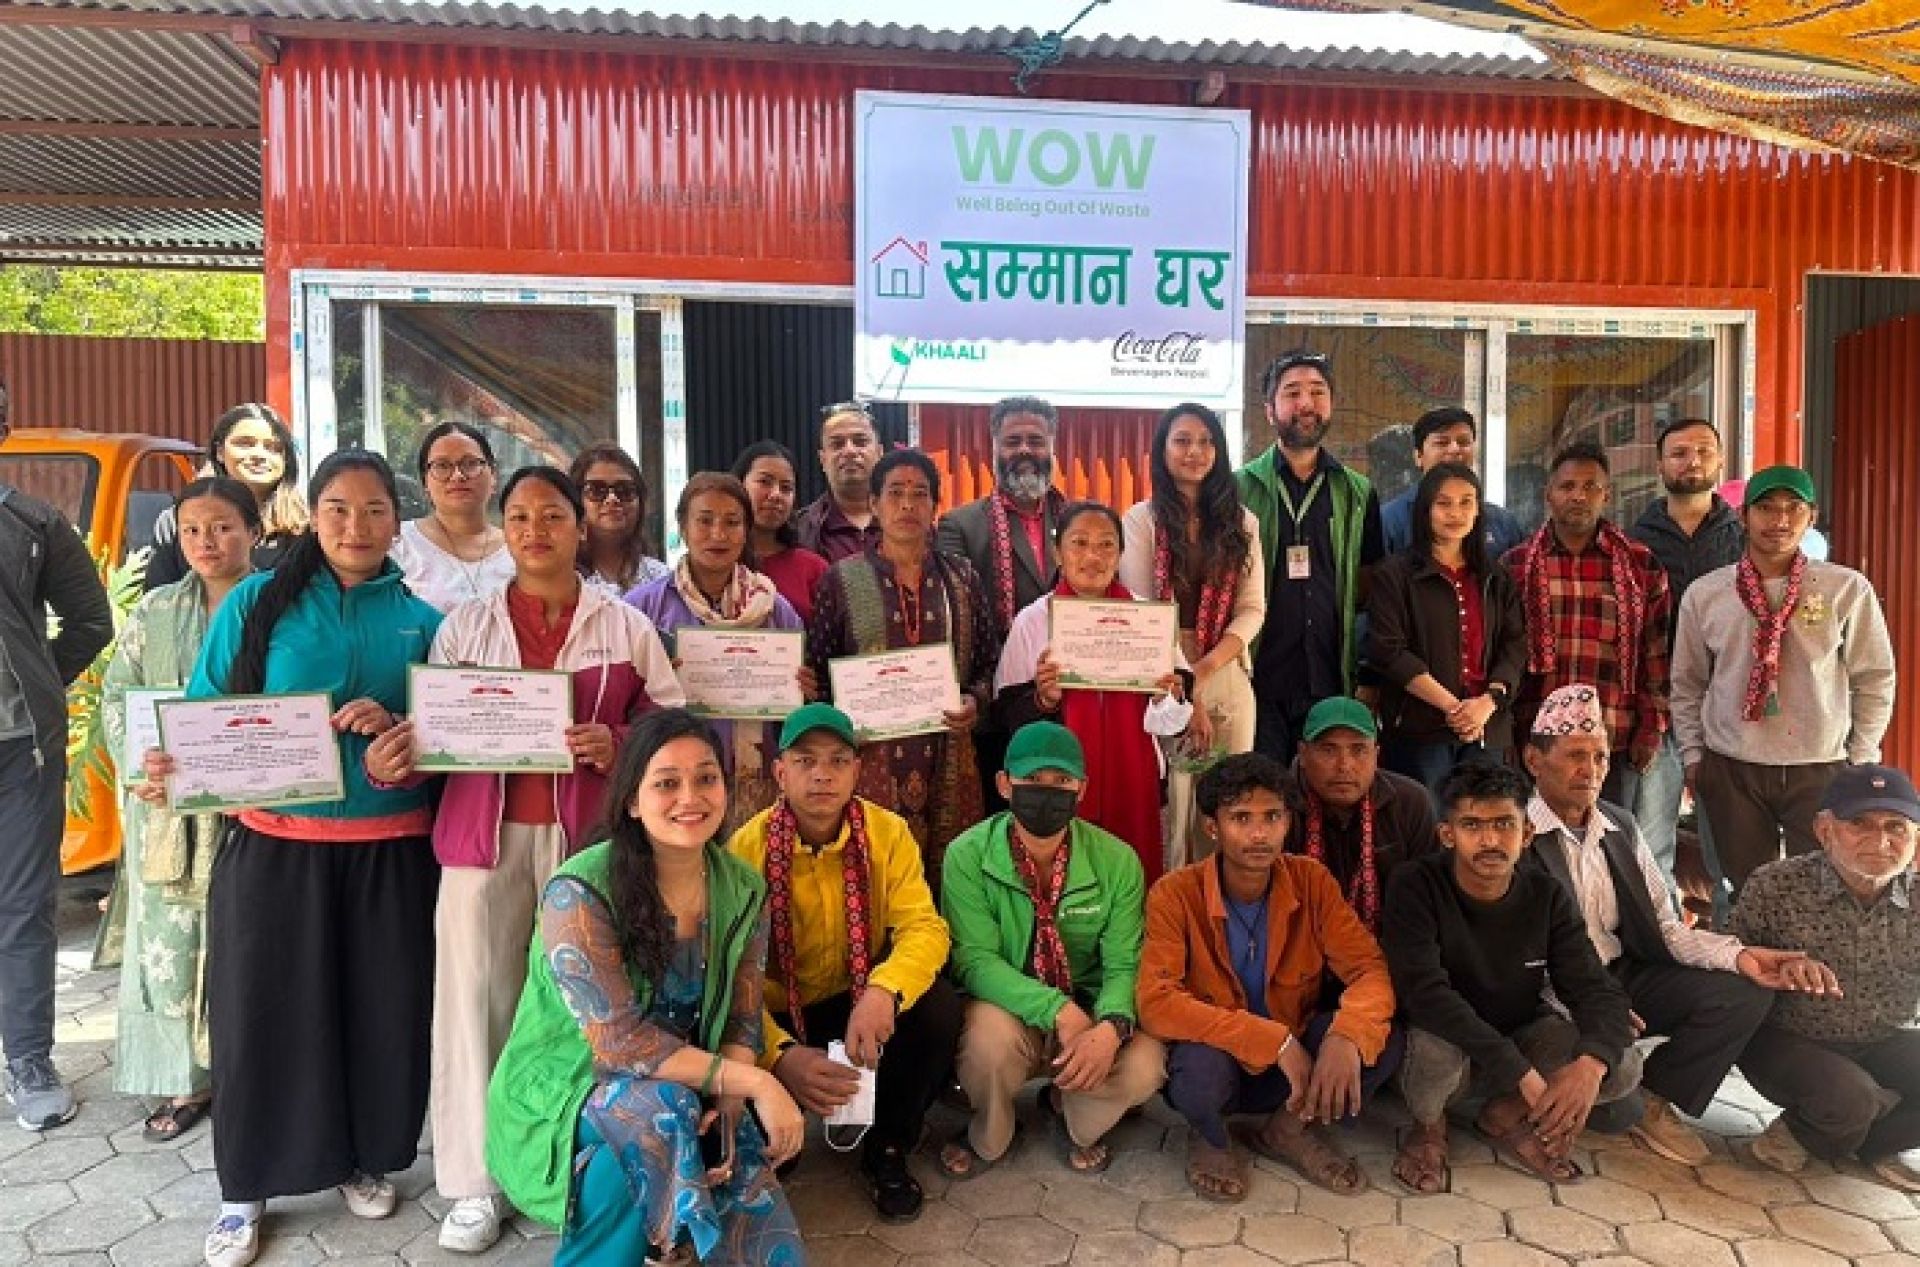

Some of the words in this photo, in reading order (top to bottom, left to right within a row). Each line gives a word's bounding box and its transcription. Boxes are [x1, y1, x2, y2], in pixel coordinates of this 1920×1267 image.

[952, 126, 1156, 189] WOW
[956, 196, 992, 212] Well
[995, 197, 1041, 217] Being
[1045, 200, 1074, 215] Out
[1077, 202, 1096, 215] Of
[1100, 202, 1150, 218] Waste
[941, 240, 1132, 306] सम्मान
[1155, 248, 1230, 310] घर
[915, 342, 986, 361] KHAALI
[1110, 366, 1172, 377] Beverages
[1174, 368, 1210, 379] Nepal
